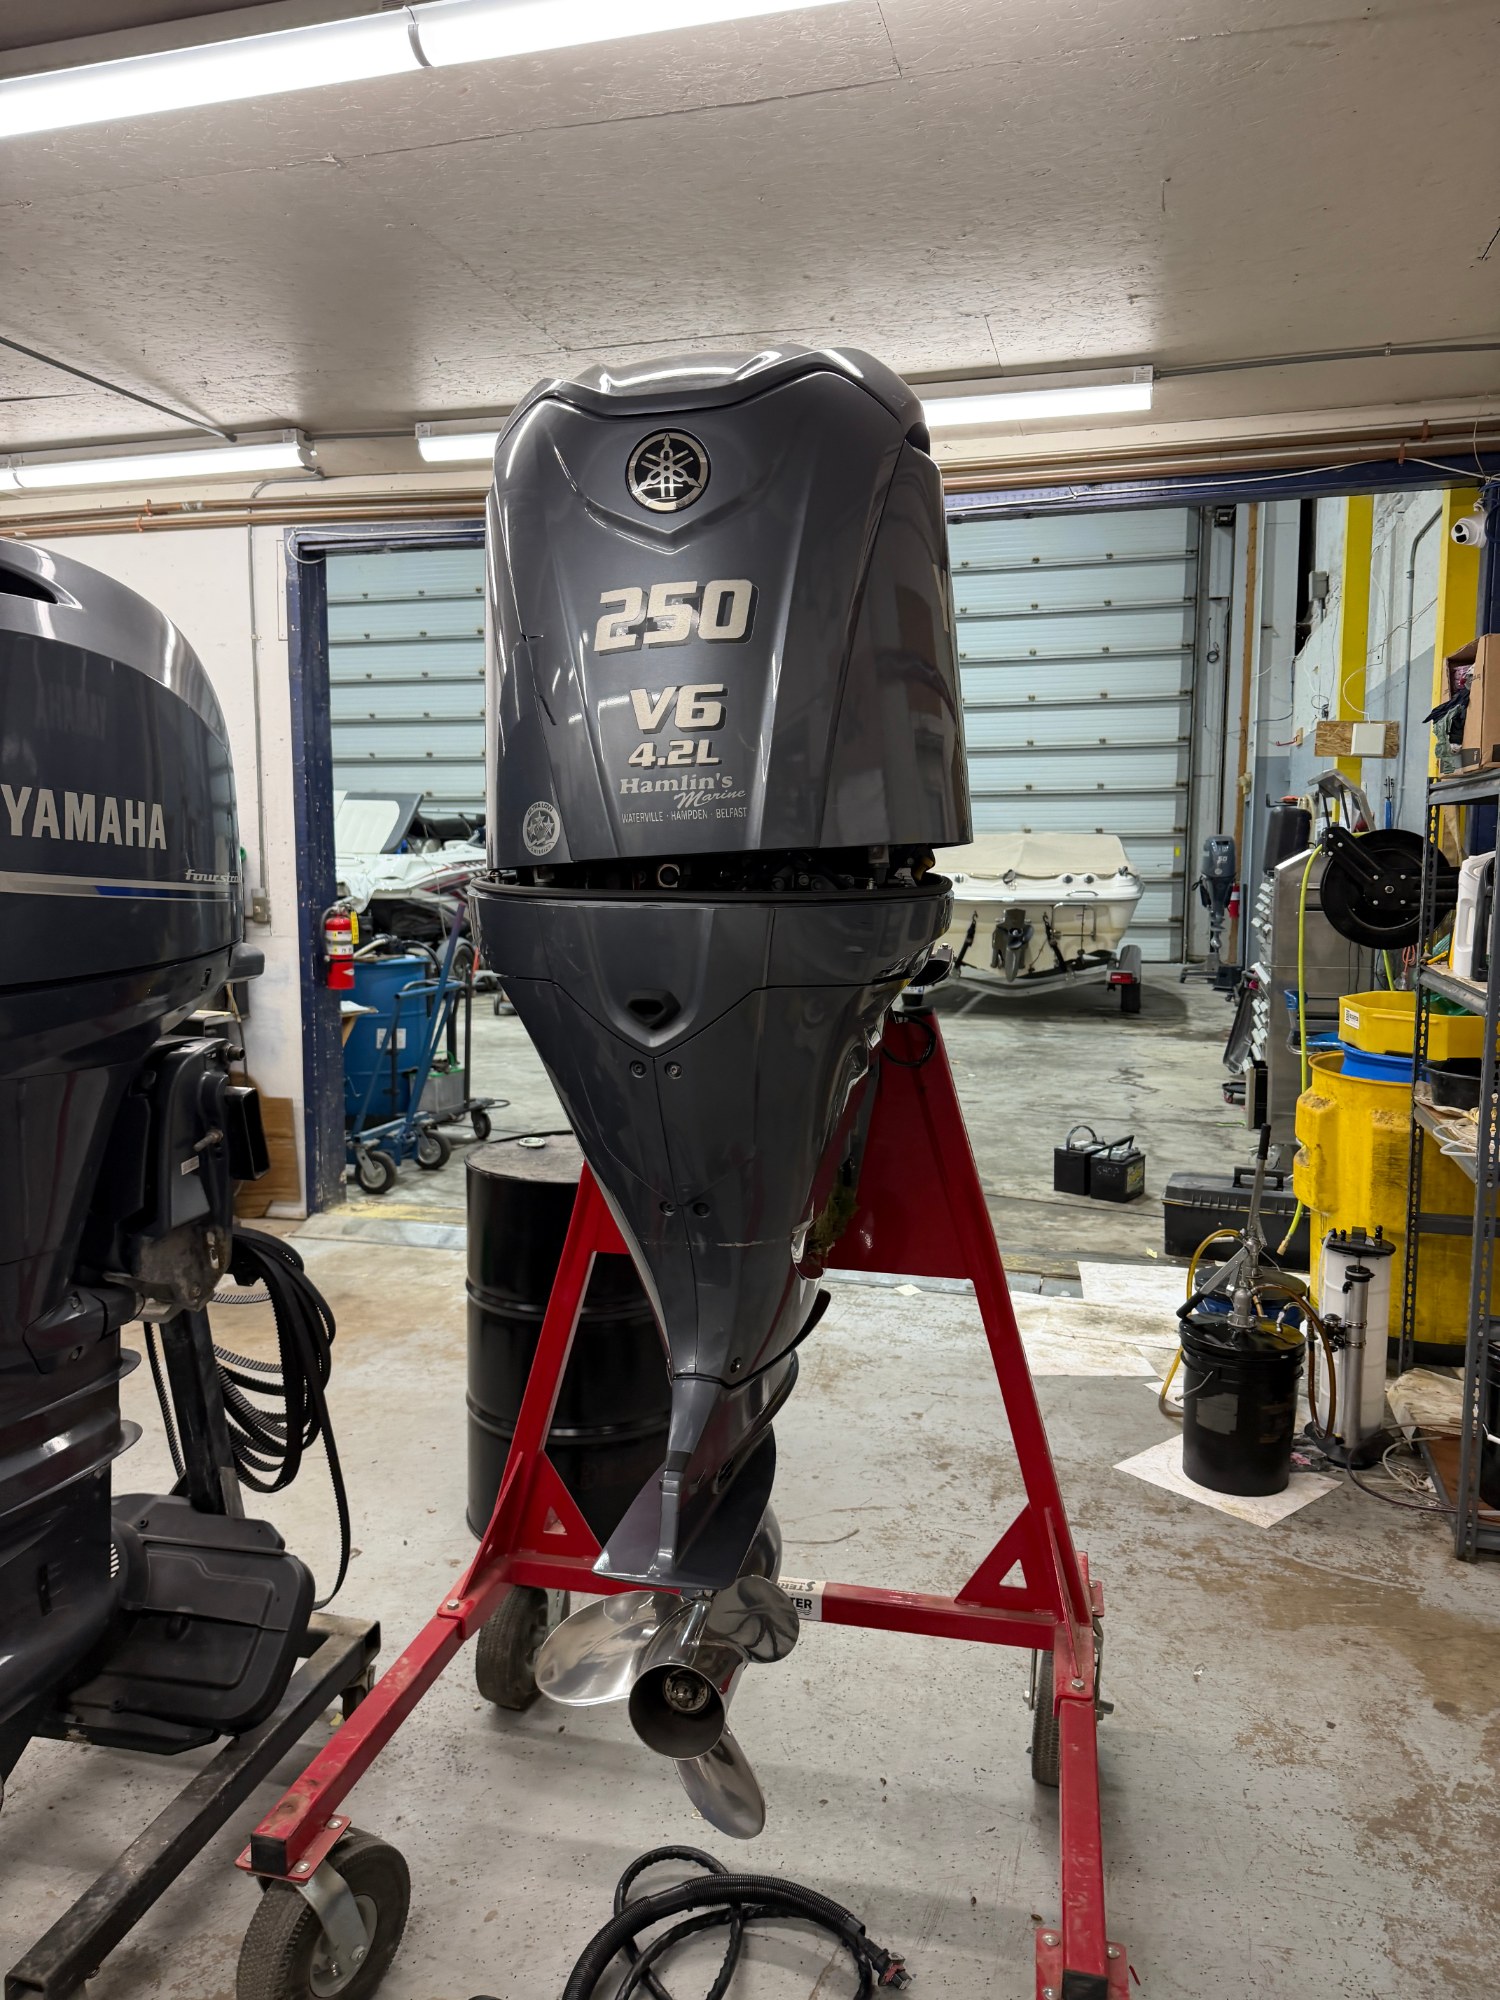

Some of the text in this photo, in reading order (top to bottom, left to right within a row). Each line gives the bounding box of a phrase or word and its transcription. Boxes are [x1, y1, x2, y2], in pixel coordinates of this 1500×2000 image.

[594, 579, 757, 653] 250
[630, 683, 726, 732] V6
[628, 739, 721, 768] 4.2L
[619, 772, 733, 794] Hamlin's
[673, 789, 747, 810] Marine
[0, 783, 167, 850] YAMAHA
[621, 807, 748, 824] WATERVILLE HAMPDEN BELFAST
